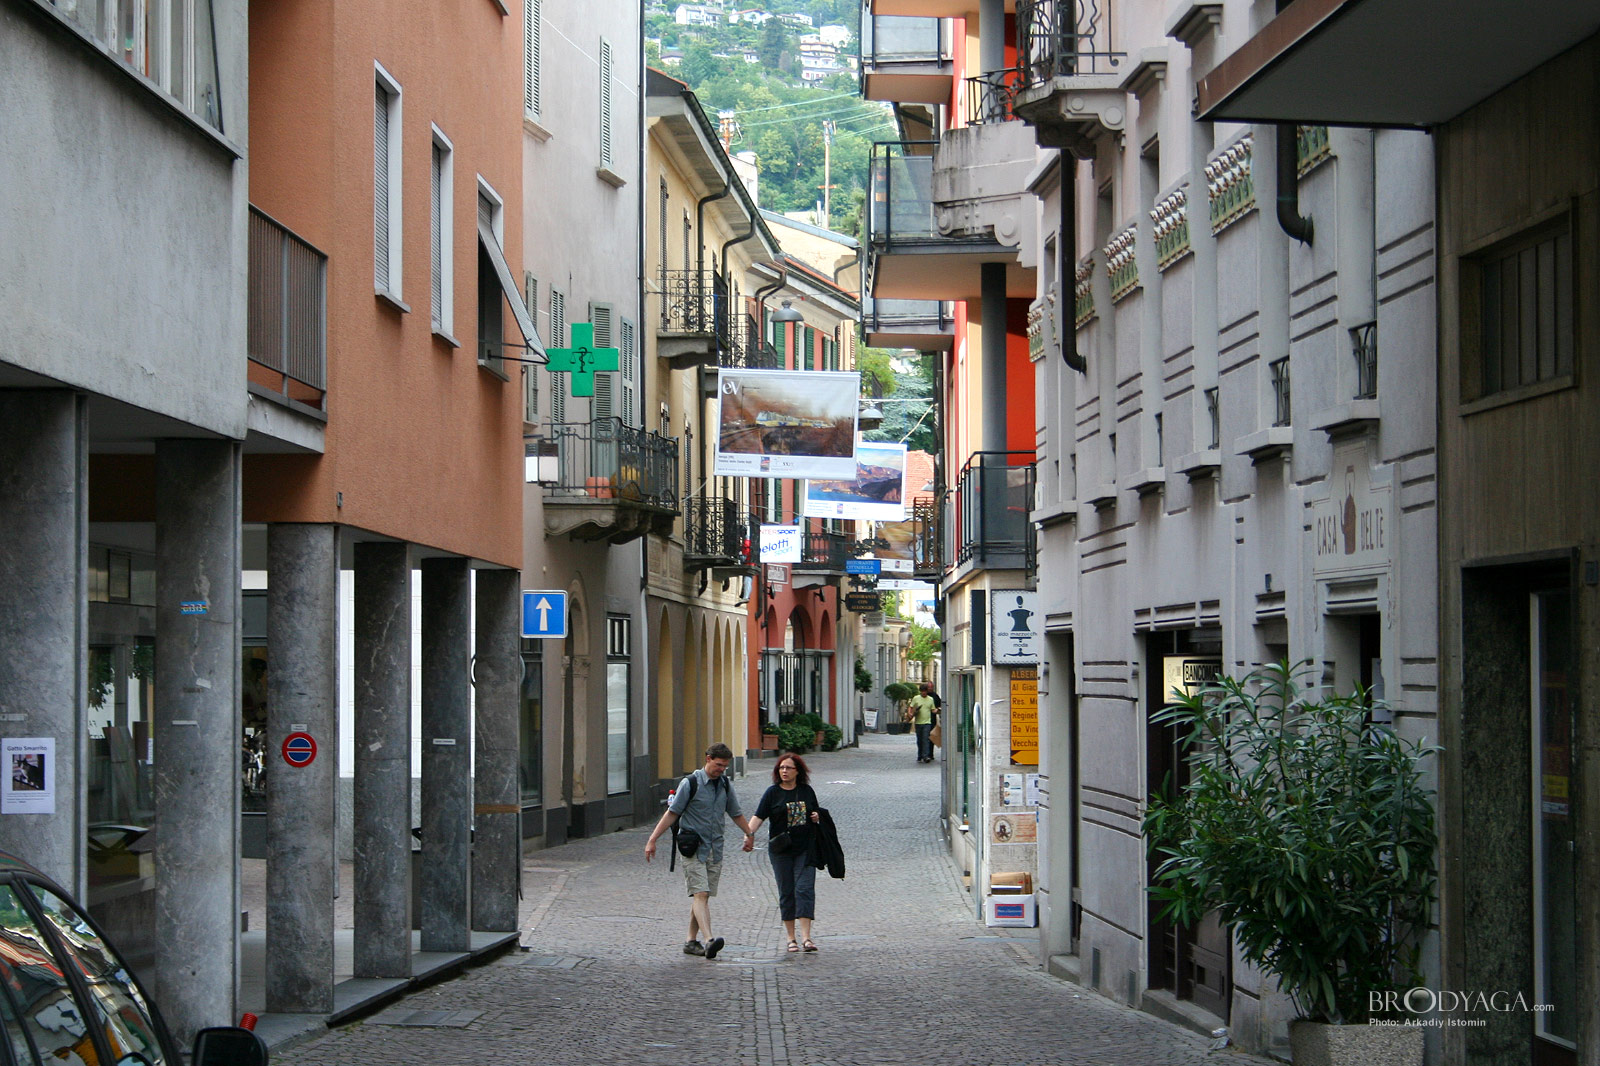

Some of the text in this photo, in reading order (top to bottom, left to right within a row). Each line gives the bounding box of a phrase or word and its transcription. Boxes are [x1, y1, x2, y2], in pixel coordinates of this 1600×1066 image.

[1317, 514, 1337, 556] CASA
[760, 537, 789, 554] elotti
[1012, 725, 1022, 733] Da
[1012, 739, 1038, 748] Vecchia
